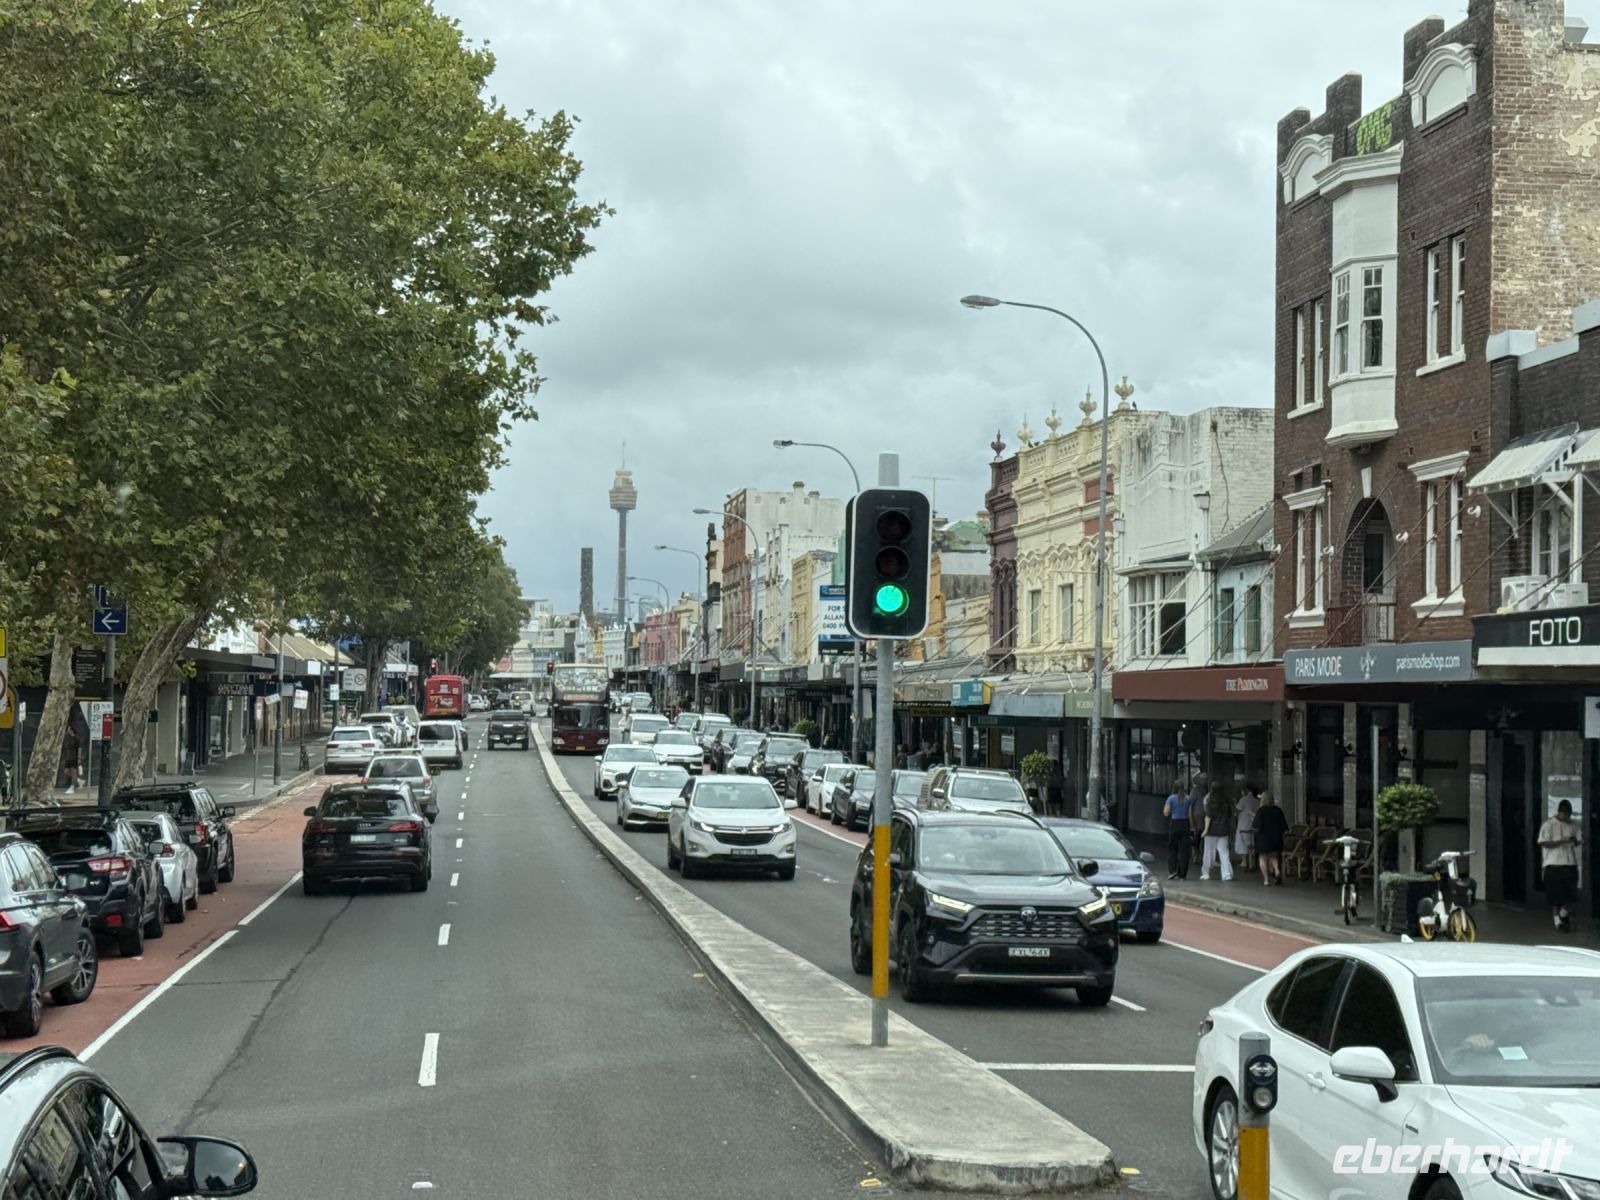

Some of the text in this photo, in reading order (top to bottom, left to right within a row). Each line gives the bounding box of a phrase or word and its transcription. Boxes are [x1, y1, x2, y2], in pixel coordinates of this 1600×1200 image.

[1529, 616, 1581, 646] FOTO
[1295, 656, 1342, 678] PARIS MODE
[1396, 653, 1460, 672] parismodeshop.com
[1226, 679, 1236, 691] THE
